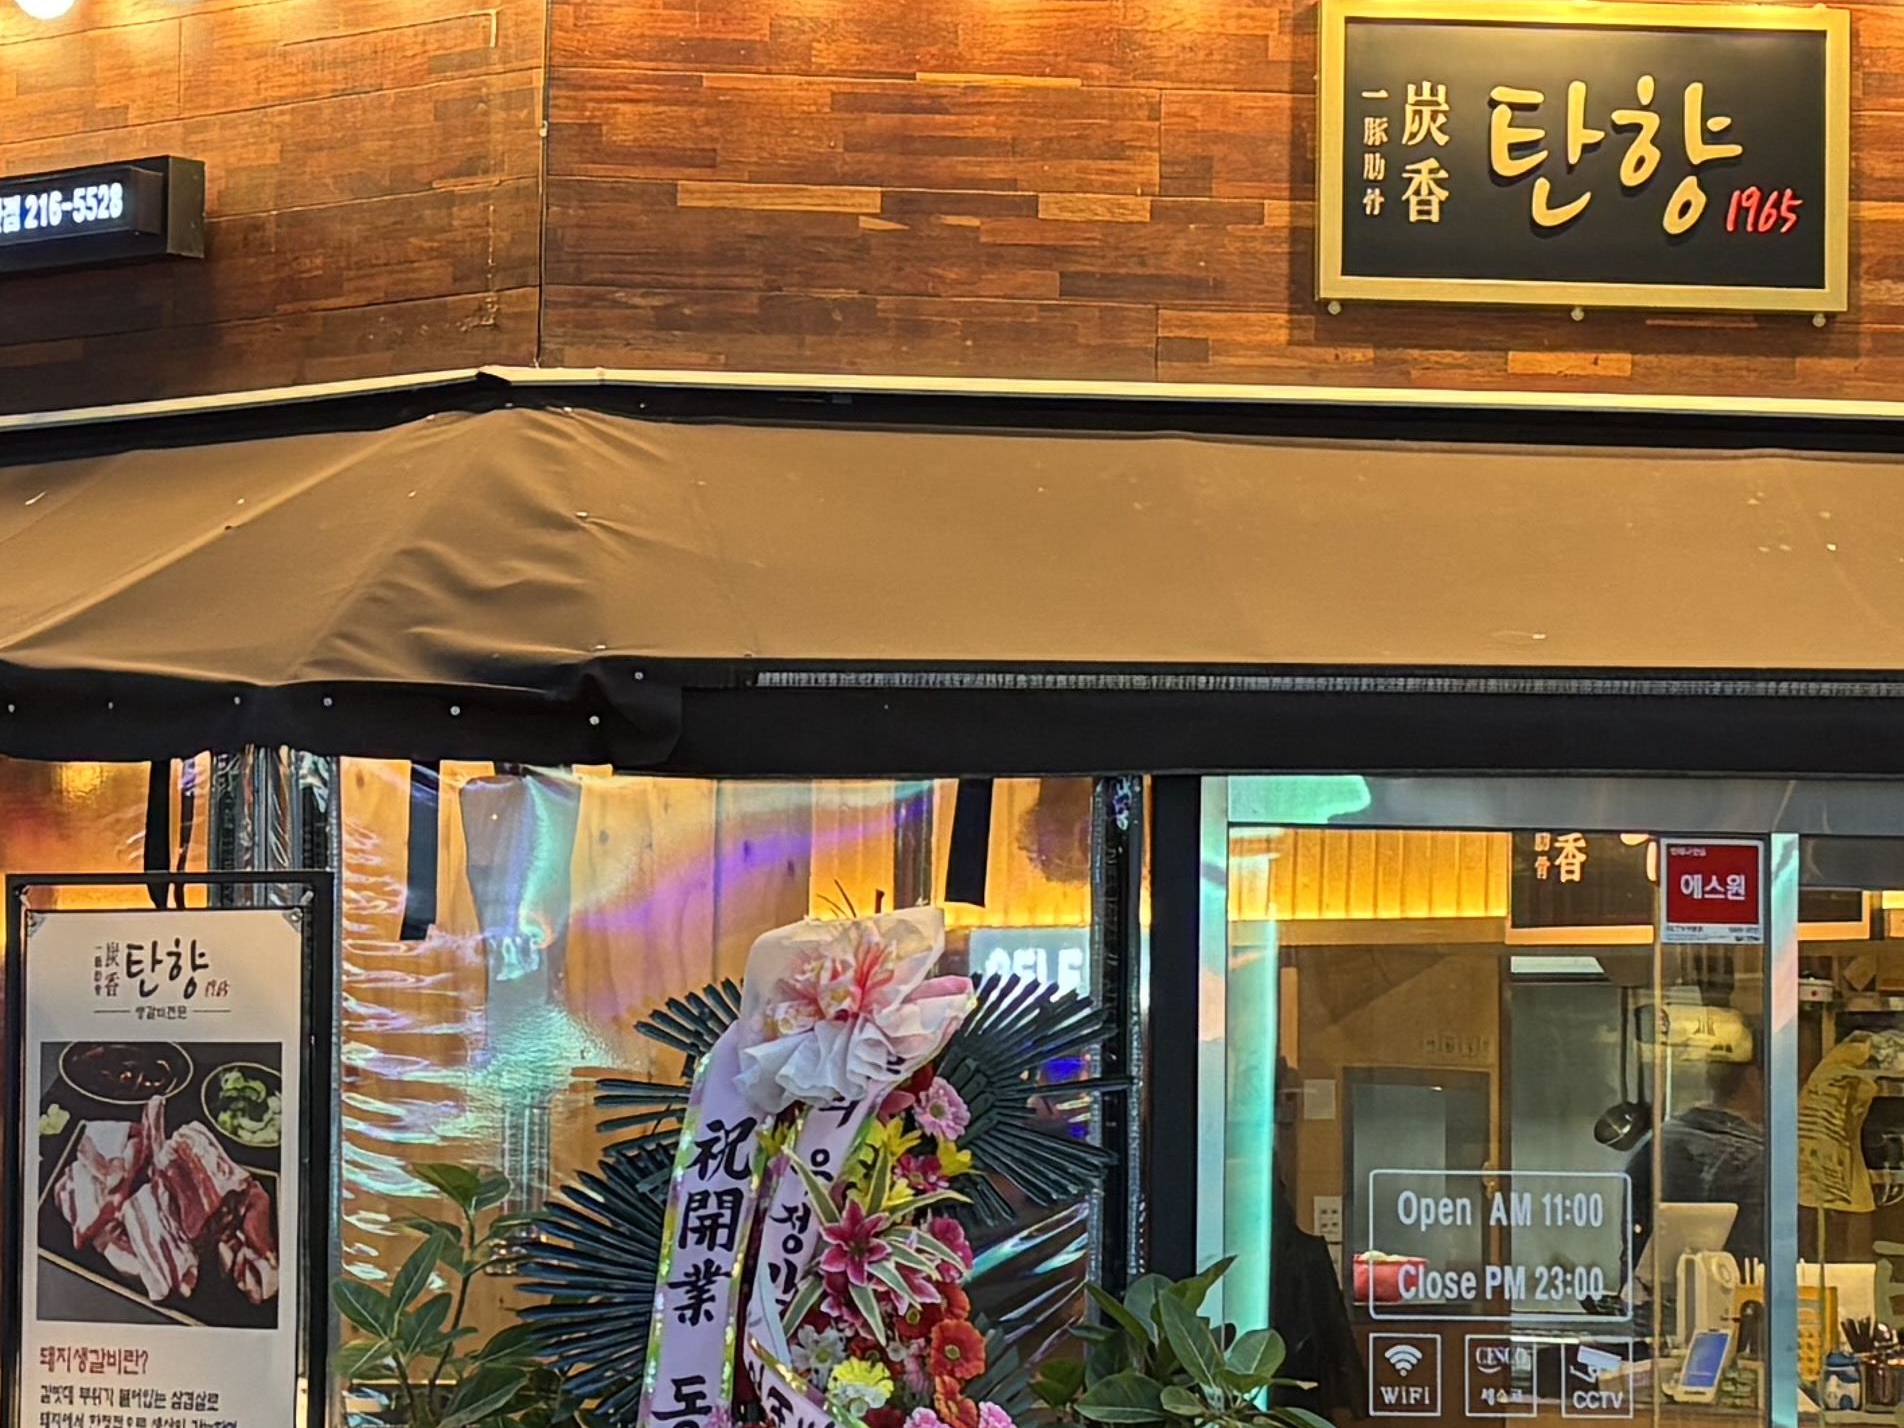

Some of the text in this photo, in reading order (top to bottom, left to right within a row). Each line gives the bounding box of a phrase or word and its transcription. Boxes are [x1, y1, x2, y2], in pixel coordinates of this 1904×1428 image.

[1401, 80, 1451, 223] 炭香
[1487, 74, 1803, 236] 탄향 1965
[23, 182, 123, 230] 216-5528
[1679, 873, 1746, 901] 에스원
[126, 937, 209, 1000] 탄향
[668, 1117, 758, 1327] 祝開業
[1398, 1190, 1605, 1233] Open AM 11:00
[1397, 1264, 1605, 1303] Close PM 23:00
[39, 1345, 149, 1375] 돼지생갈비란?
[79, 1387, 115, 1408] 부위가
[170, 1390, 220, 1412] 삼겹살로
[1572, 1390, 1624, 1410] CCTV
